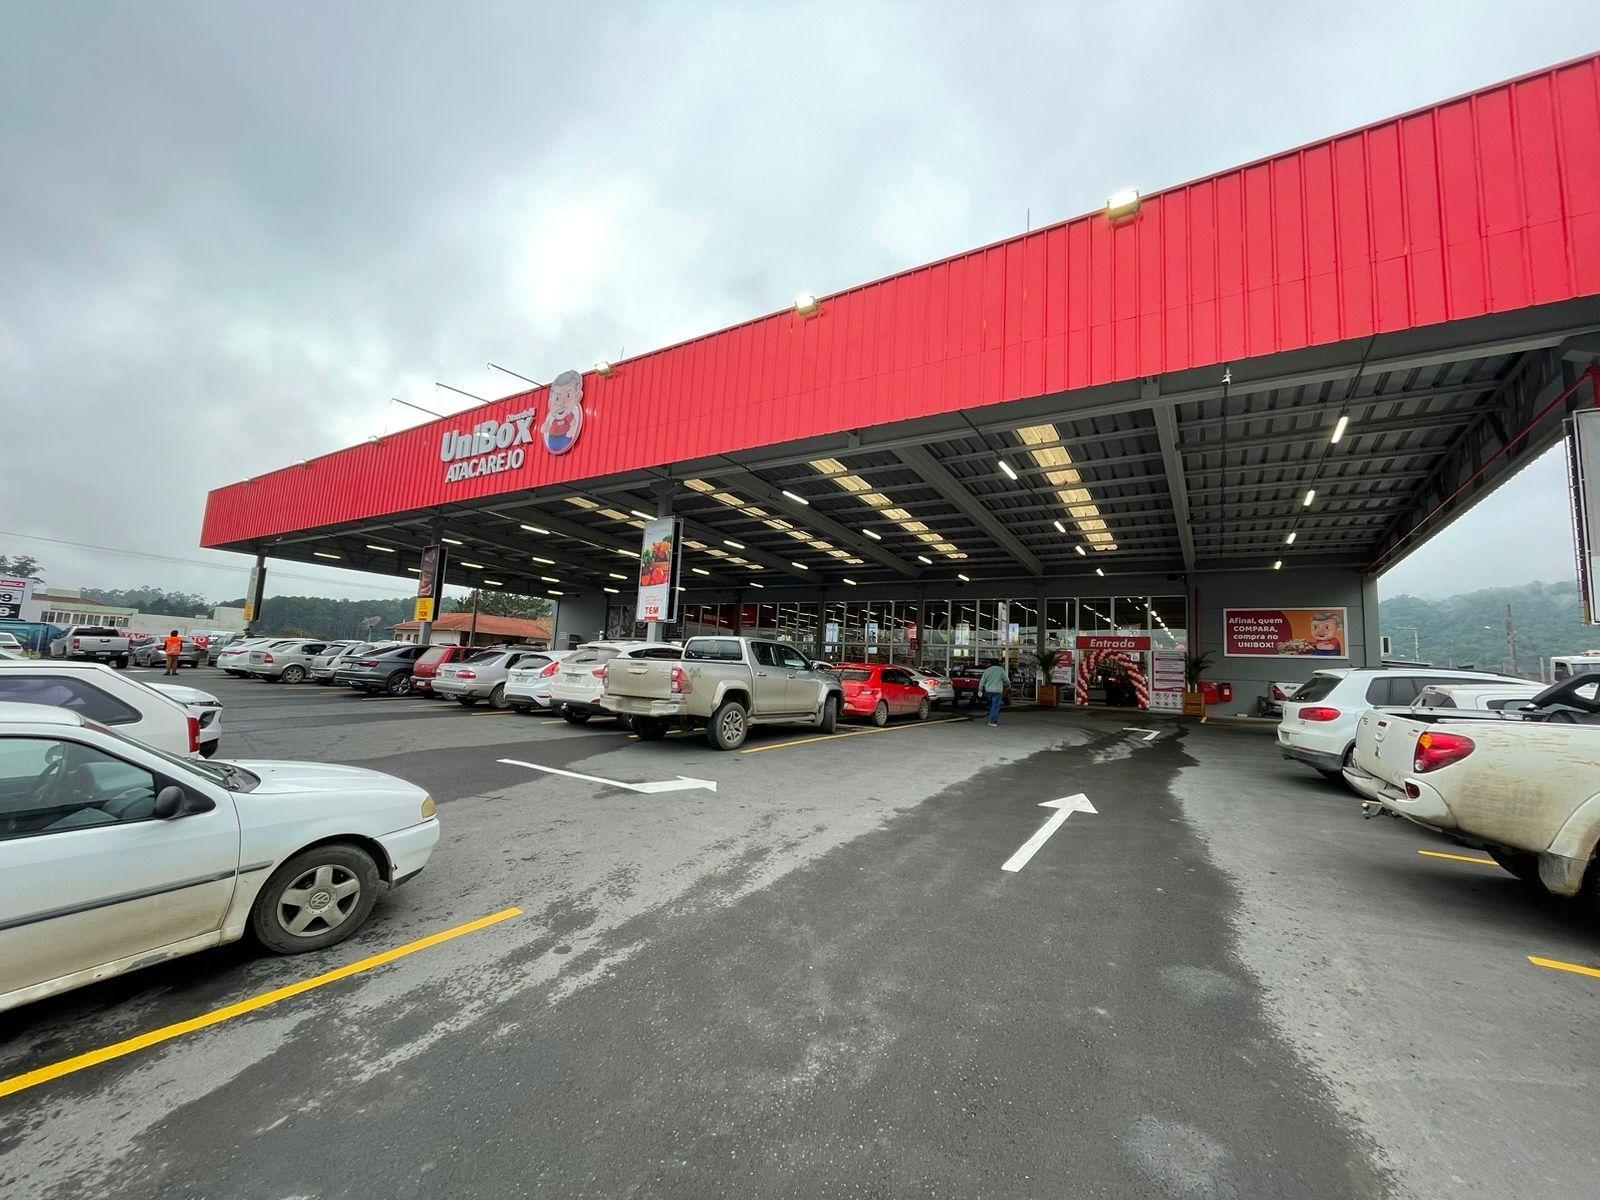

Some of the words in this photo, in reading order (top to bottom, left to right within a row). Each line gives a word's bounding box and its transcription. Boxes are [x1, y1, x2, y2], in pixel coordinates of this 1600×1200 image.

[445, 448, 525, 483] ATACAREJO
[644, 606, 659, 615] TEM
[1090, 638, 1135, 648] Entrada
